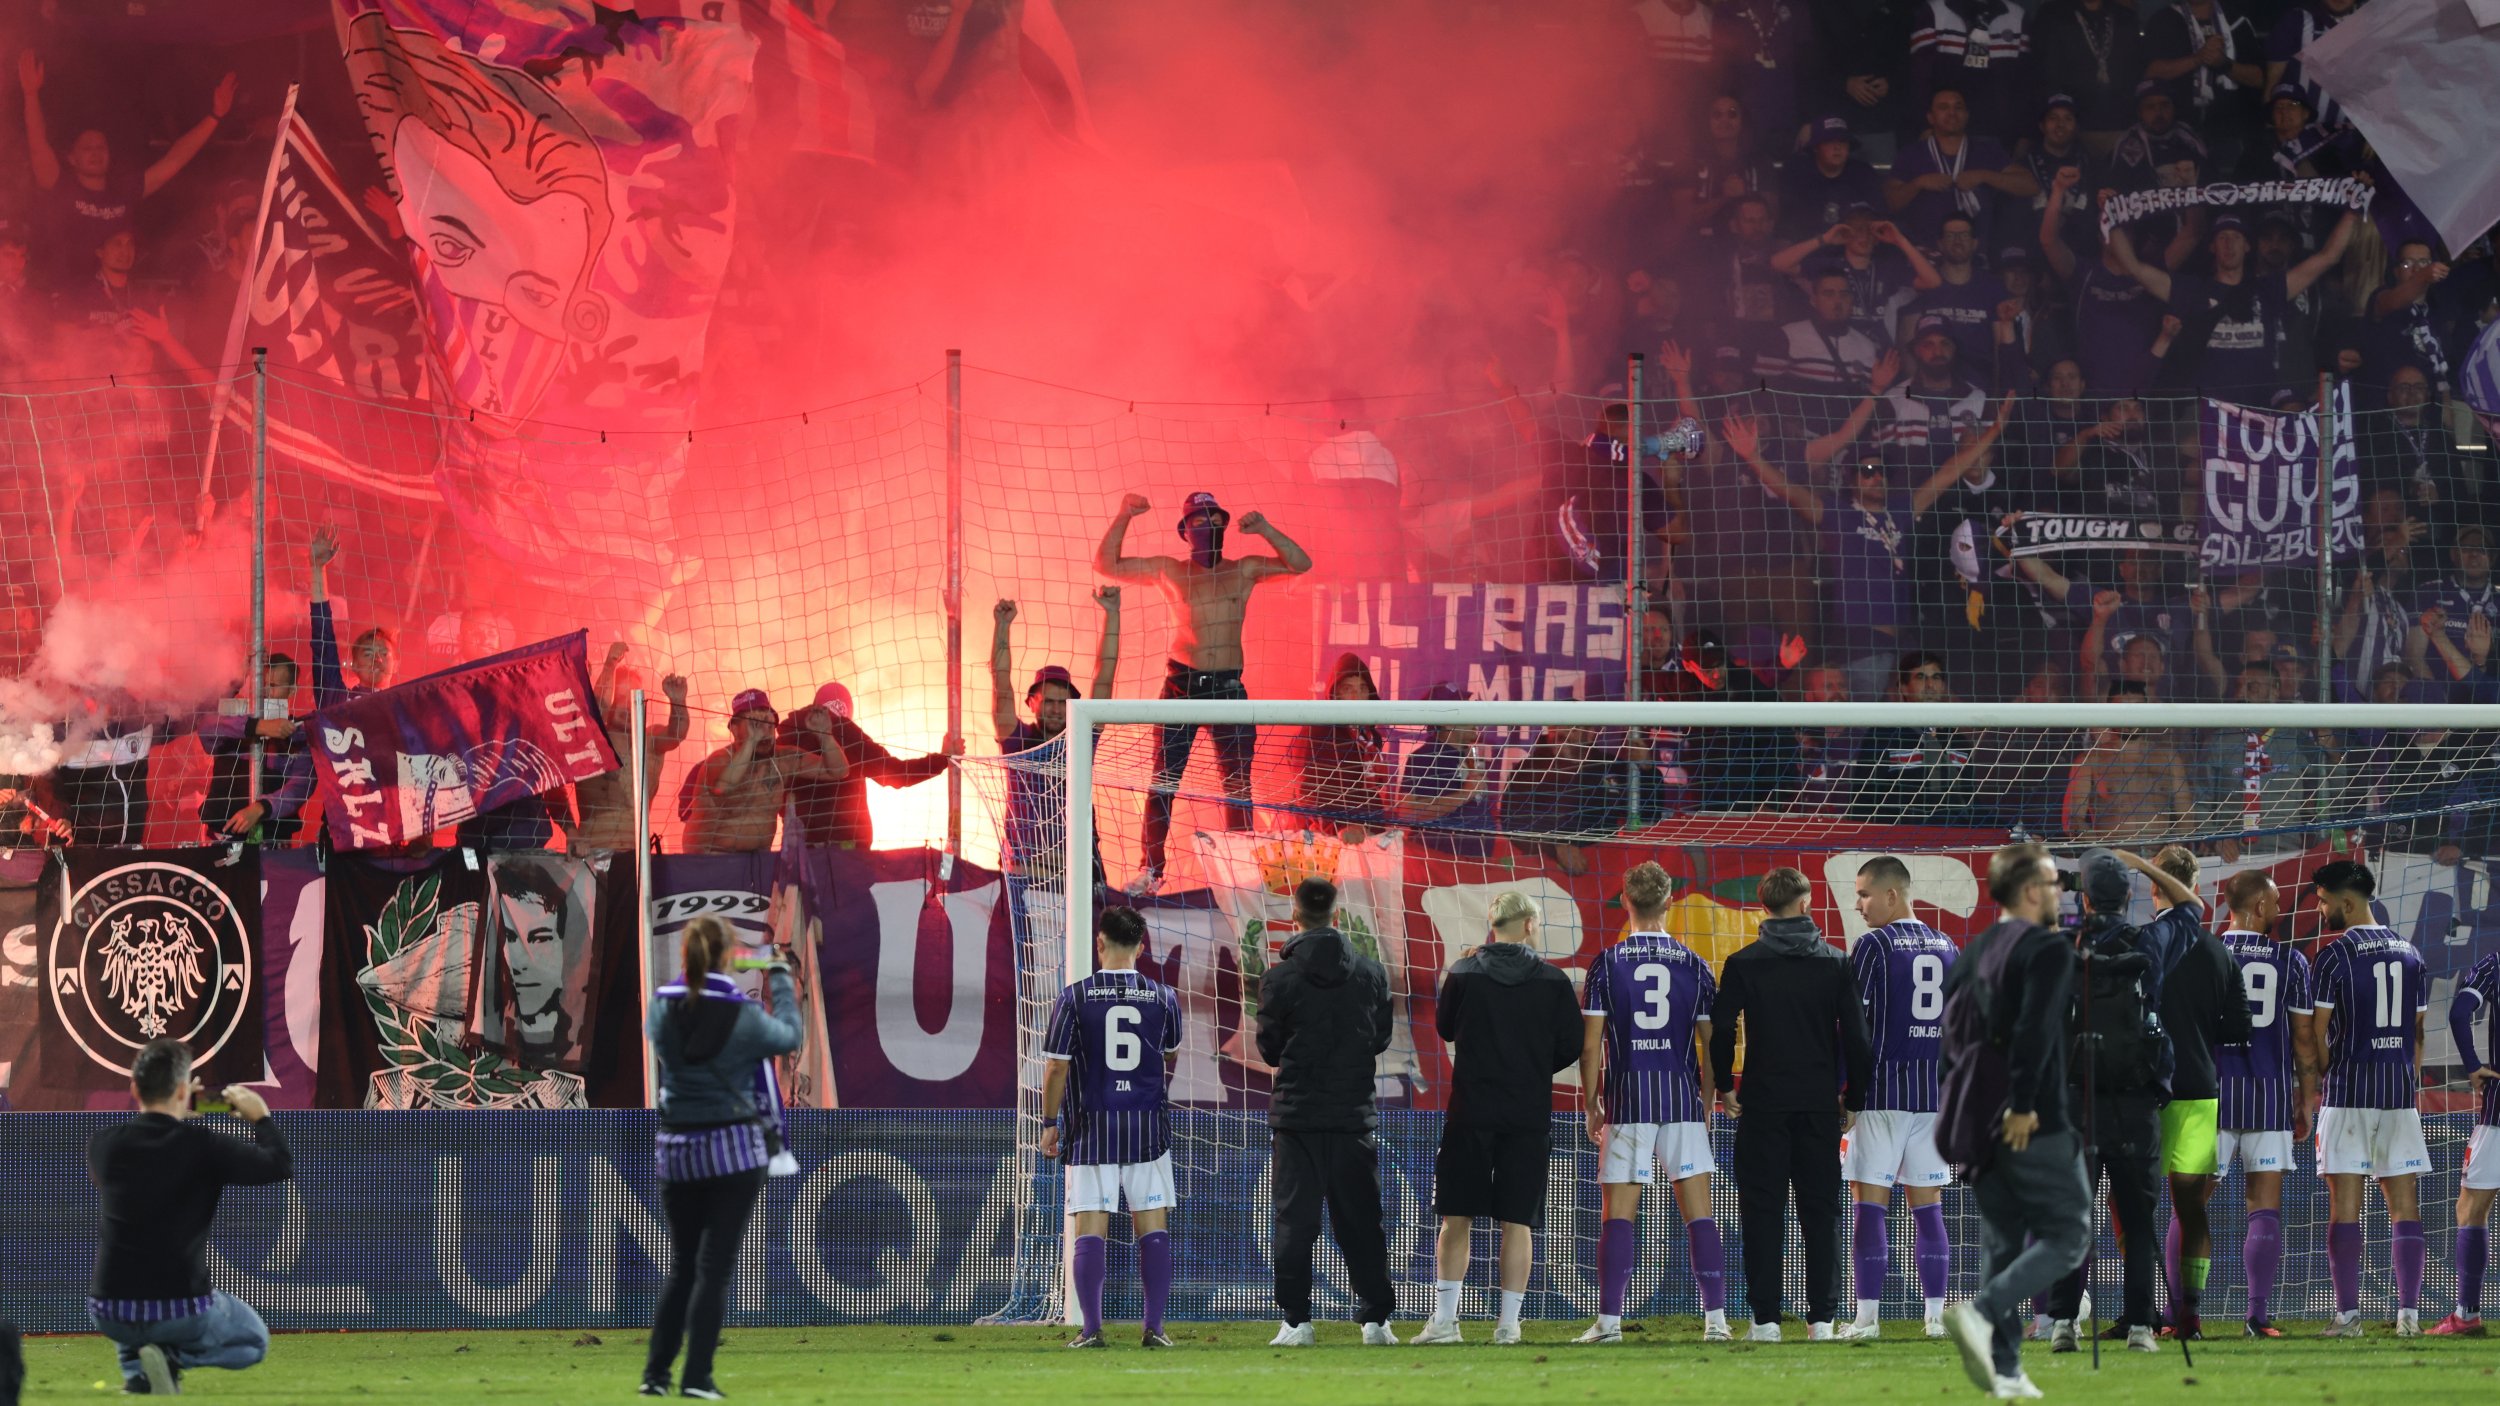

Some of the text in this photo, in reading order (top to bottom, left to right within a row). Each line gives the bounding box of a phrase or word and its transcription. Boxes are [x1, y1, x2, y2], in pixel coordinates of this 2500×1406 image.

[2206, 441, 2359, 533] GUYS
[2026, 519, 2129, 543] TOUGH
[1328, 581, 1625, 661] ULTRAS
[544, 687, 606, 783] ULT
[323, 727, 392, 848] SALZ
[73, 871, 225, 928] CASSACCO
[656, 895, 771, 919] 1999
[1894, 938, 1917, 946] ROWA
[2358, 940, 2383, 952] ROWA
[1619, 946, 1648, 955] ROWA
[1656, 945, 1687, 957] MOSER
[2241, 945, 2274, 954] MOSER
[1087, 987, 1117, 997] ROWA
[1124, 988, 1156, 998] MOSER
[1911, 954, 1944, 1020] 8
[1633, 963, 1671, 1029] 3
[2373, 960, 2403, 1028] 11
[1105, 1005, 1142, 1071] 6
[1631, 1038, 1672, 1051] TRKULJA
[1115, 1080, 1131, 1092] ZIA
[2260, 1156, 2276, 1166] PKE
[2360, 1160, 2373, 1169] PK
[2405, 1159, 2422, 1168] PKE
[1885, 1173, 1896, 1182] PK
[1929, 1172, 1944, 1181] PKE
